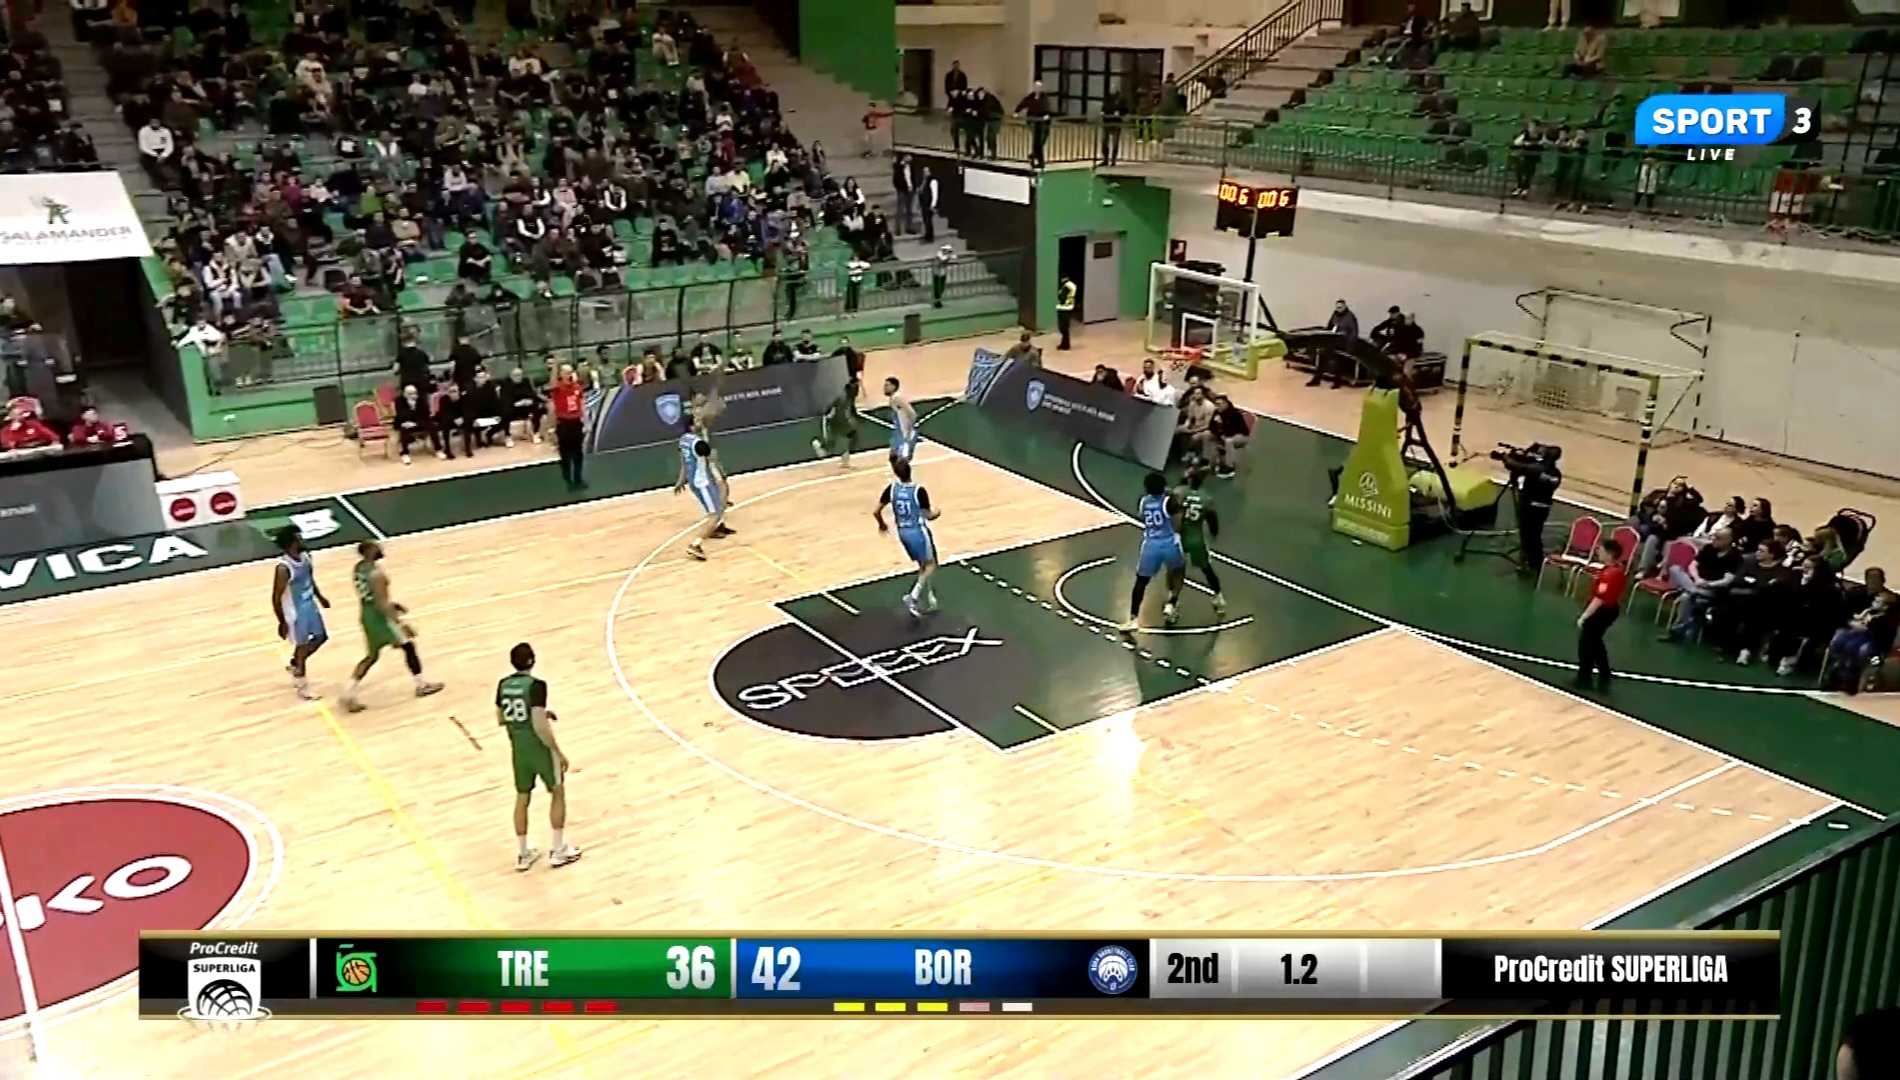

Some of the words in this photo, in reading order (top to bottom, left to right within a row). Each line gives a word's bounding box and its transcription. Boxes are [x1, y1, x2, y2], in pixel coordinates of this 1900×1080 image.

[1144, 510, 1163, 526] 20
[1344, 493, 1392, 519] MISSINI
[502, 698, 528, 722] 28
